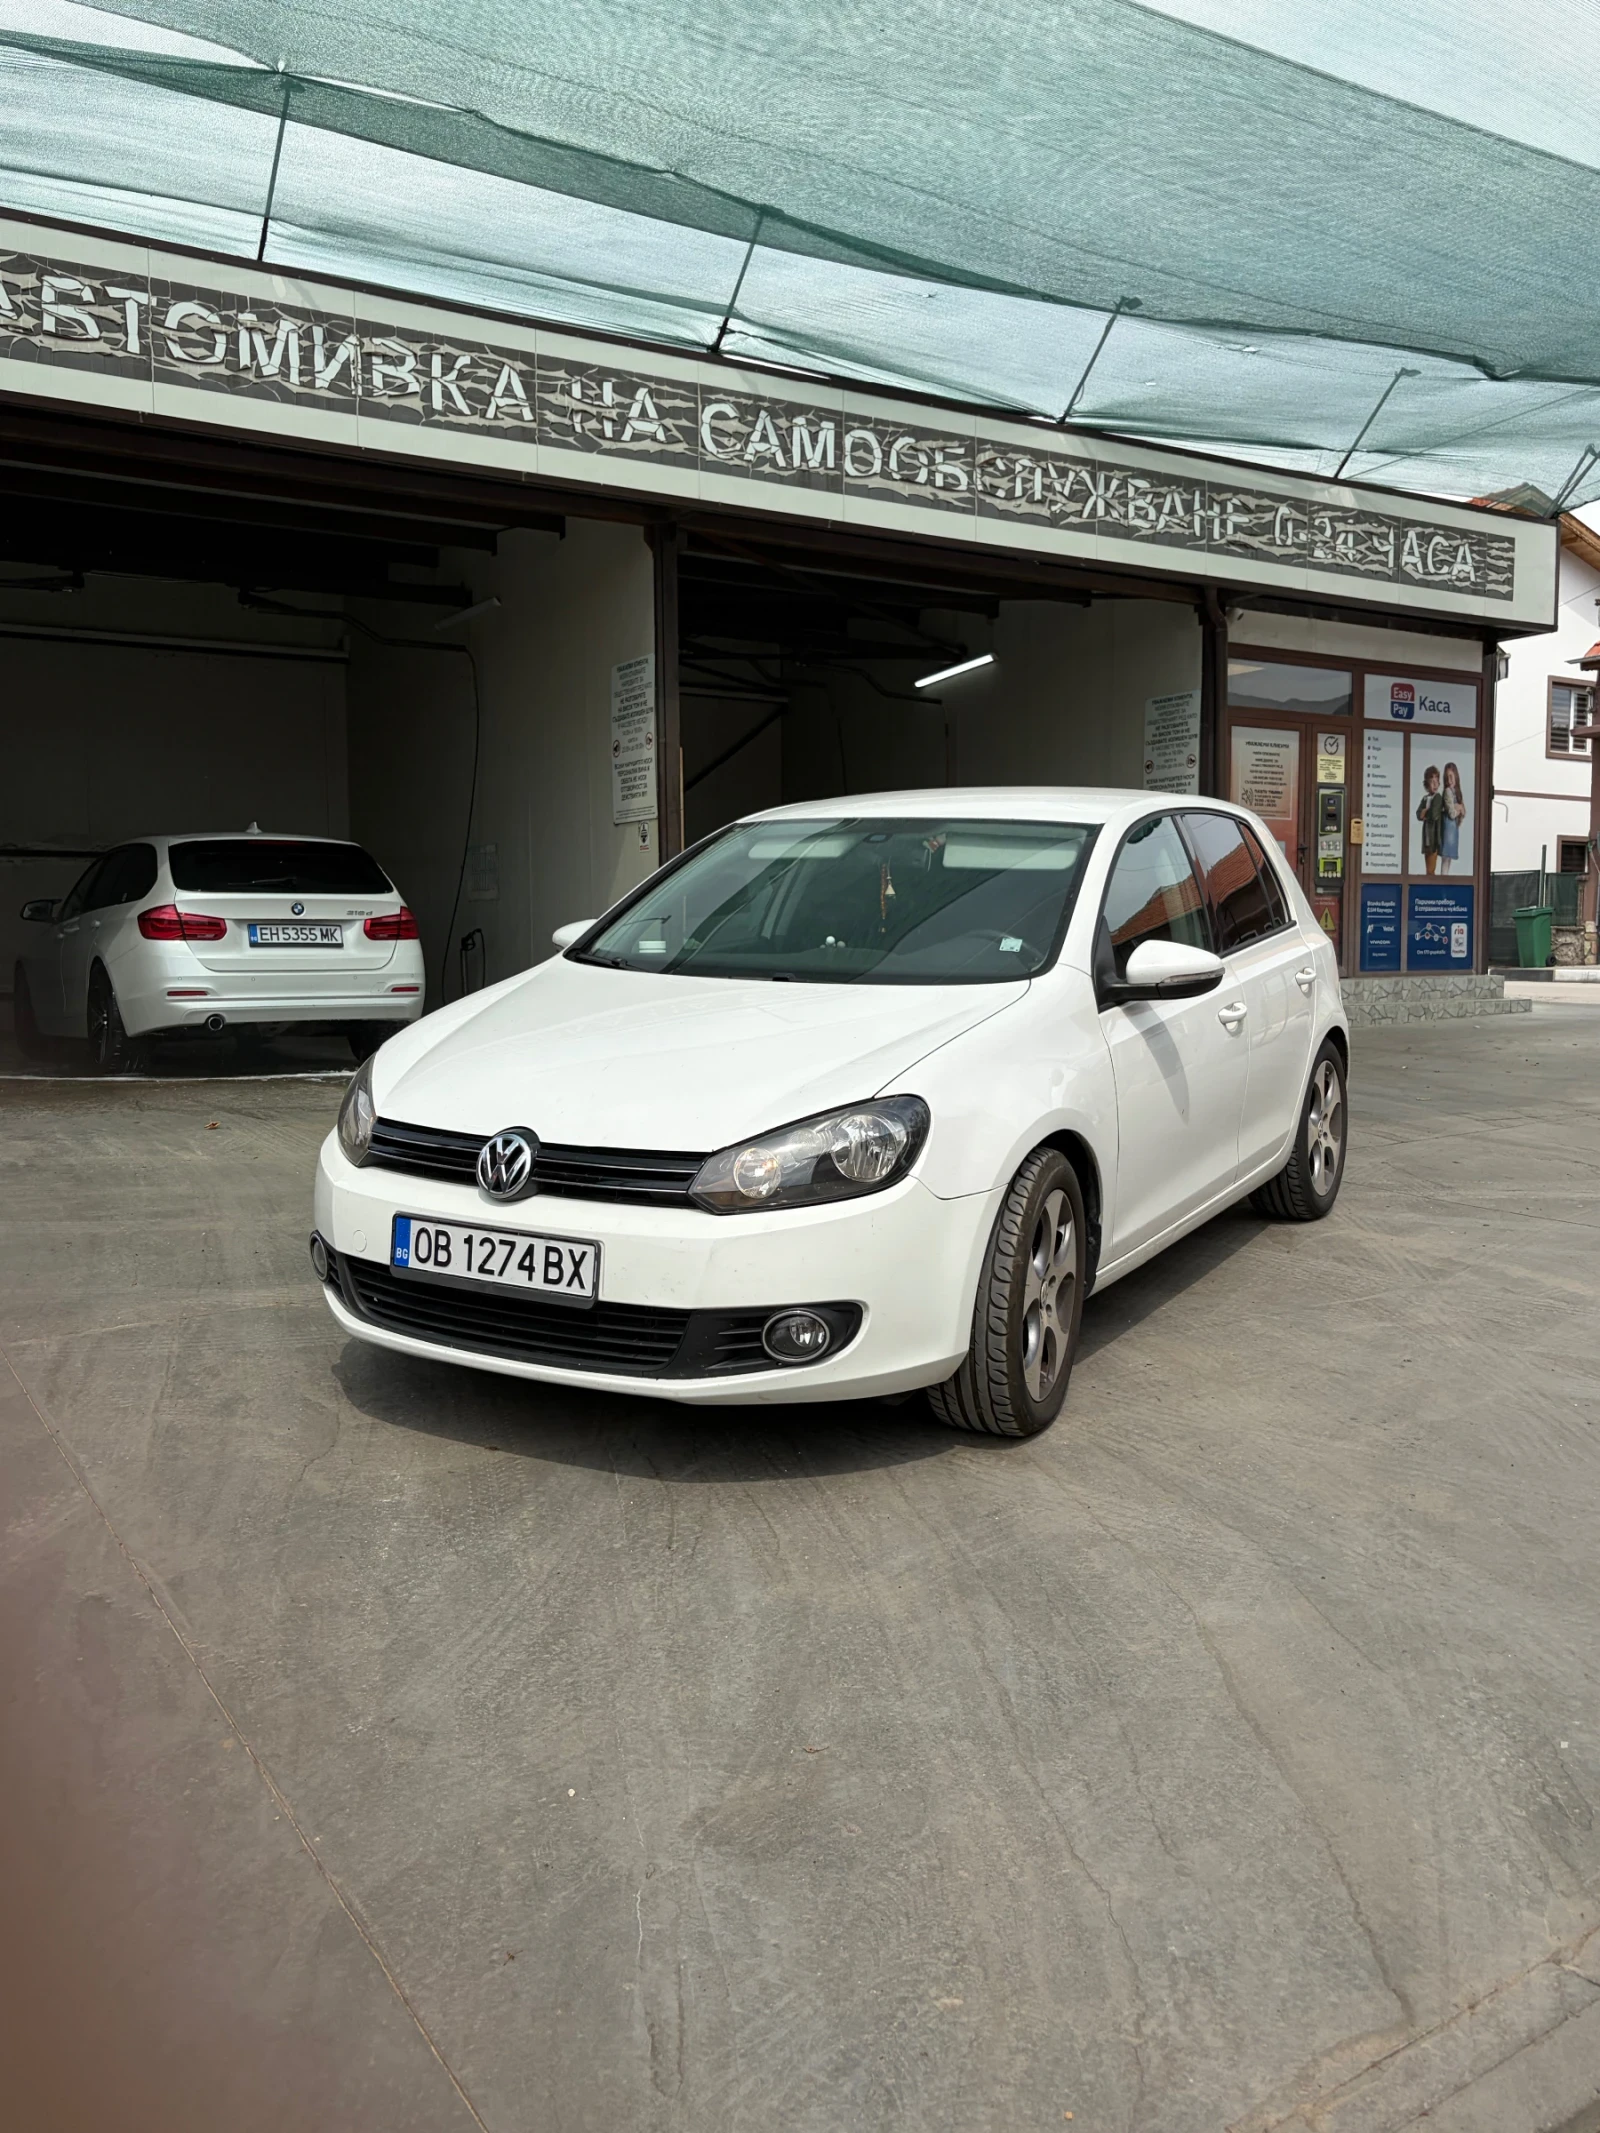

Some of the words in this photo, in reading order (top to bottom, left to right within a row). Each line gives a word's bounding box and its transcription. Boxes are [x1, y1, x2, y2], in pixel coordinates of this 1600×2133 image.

[568, 375, 668, 443] НА
[701, 402, 1250, 541] САМООБСЛУЖВАНЕ
[1371, 521, 1476, 582] ЧАСА
[1393, 687, 1412, 701] Easy
[1393, 703, 1408, 717] Pay
[1419, 696, 1451, 713] Каса
[260, 927, 279, 941] EH
[282, 928, 318, 941] 5355
[320, 928, 339, 942] MK
[396, 1248, 408, 1259] BG
[414, 1227, 452, 1267] OB
[463, 1234, 536, 1282] 1274
[543, 1246, 588, 1290] BX
